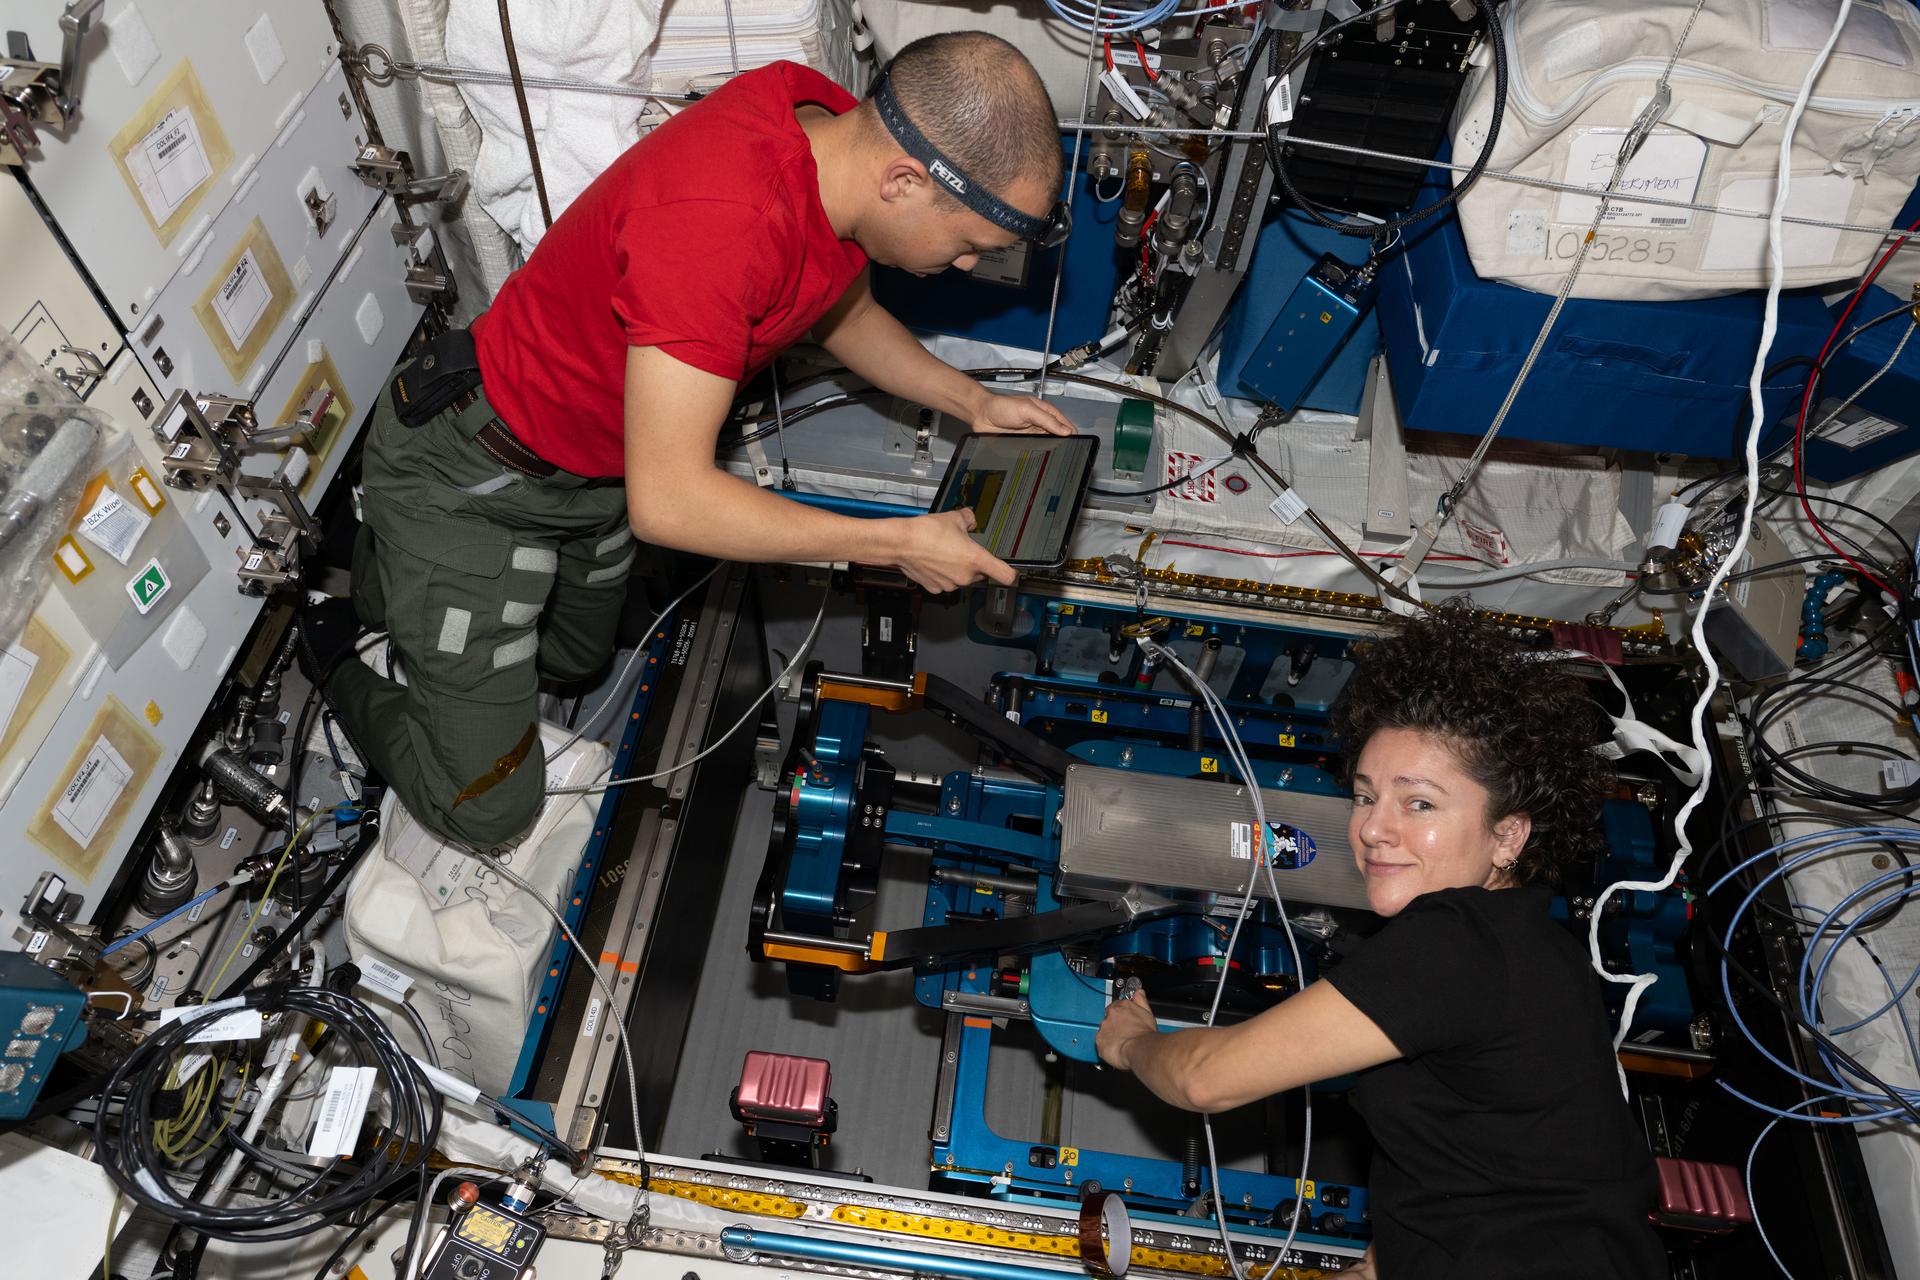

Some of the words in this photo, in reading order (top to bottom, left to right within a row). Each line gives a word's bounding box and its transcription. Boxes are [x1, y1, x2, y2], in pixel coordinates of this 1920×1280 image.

[929, 158, 966, 194] PETZL
[86, 511, 103, 527] BZK
[102, 498, 122, 515] Wipe
[31, 935, 42, 950] LOCK
[585, 1006, 598, 1032] COL14D
[508, 1223, 523, 1246] POWER
[502, 1246, 511, 1257] ON
[450, 1253, 463, 1271] OFF
[479, 1268, 491, 1280] ON
